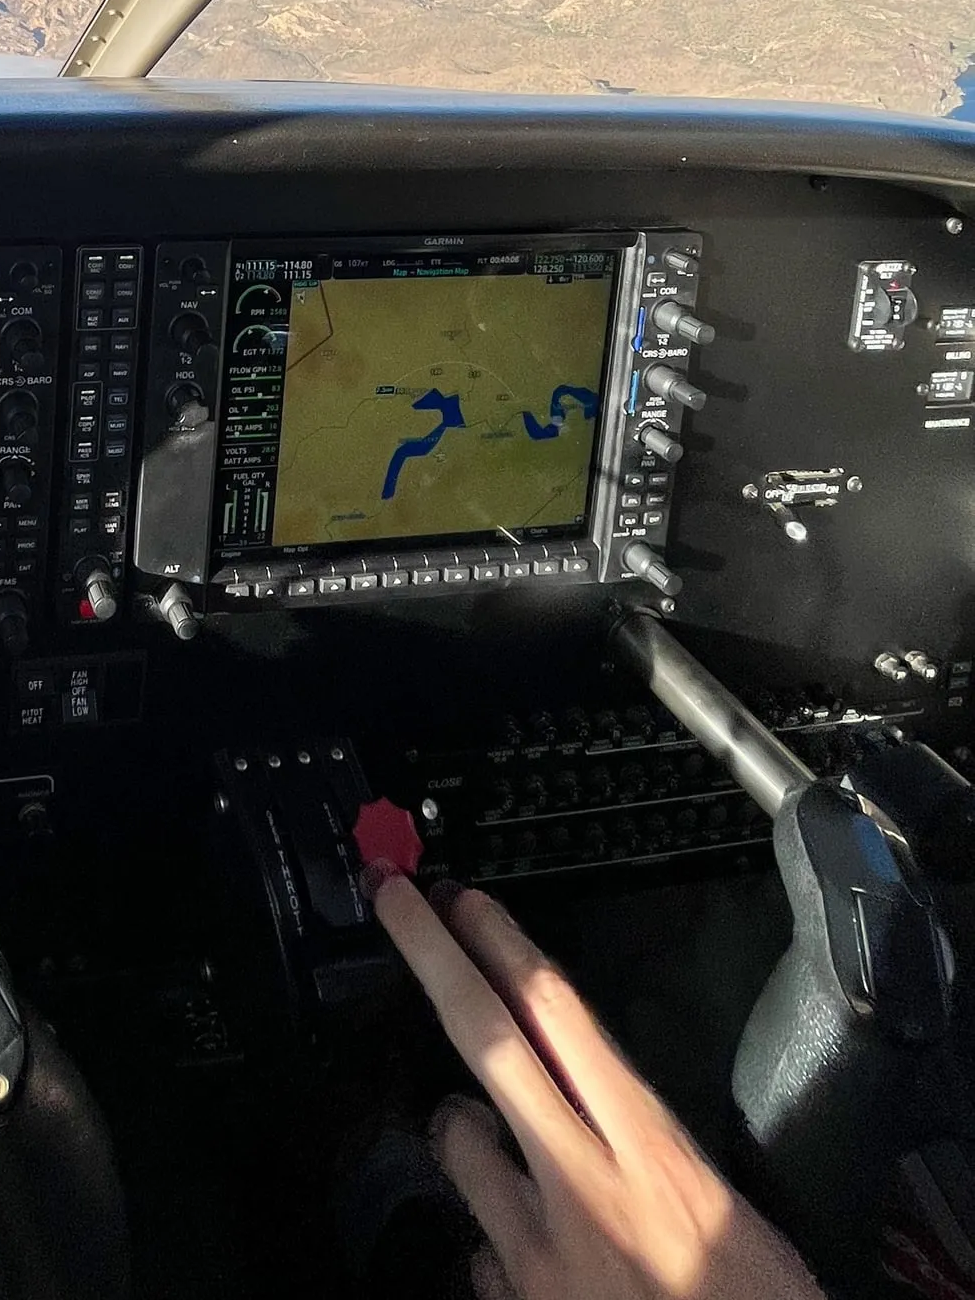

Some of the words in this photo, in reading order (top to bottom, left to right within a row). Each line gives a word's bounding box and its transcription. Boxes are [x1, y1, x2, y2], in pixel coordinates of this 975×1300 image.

[424, 238, 464, 246] GARMIN
[574, 255, 604, 263] 120.600
[247, 262, 275, 270] 111.15
[284, 261, 313, 270] 114.80
[533, 264, 564, 273] 128.250
[283, 271, 312, 280] 111.15
[393, 268, 407, 277] Map
[416, 268, 453, 276] Navigation
[454, 267, 469, 275] Map
[660, 287, 678, 295] COM
[180, 301, 199, 309] NAV
[11, 307, 33, 316] COM
[642, 350, 658, 358] CRS
[668, 349, 688, 357] BARO
[180, 357, 193, 365] 1-2
[27, 376, 53, 385] BARO
[642, 410, 667, 418] RANGE
[0, 446, 31, 454] RANGE
[225, 447, 247, 455] VOLTS
[826, 486, 840, 494] ON
[164, 565, 180, 574] ALT
[0, 578, 17, 586] FMS
[72, 670, 88, 678] FAN
[28, 680, 44, 691] OFF
[71, 678, 89, 687] HIGH
[72, 687, 86, 695] OFF
[71, 698, 87, 708] FAN
[21, 708, 44, 717] PITOT
[72, 706, 89, 716] LOW
[22, 716, 42, 726] HEAT
[427, 776, 464, 789] CLOSE
